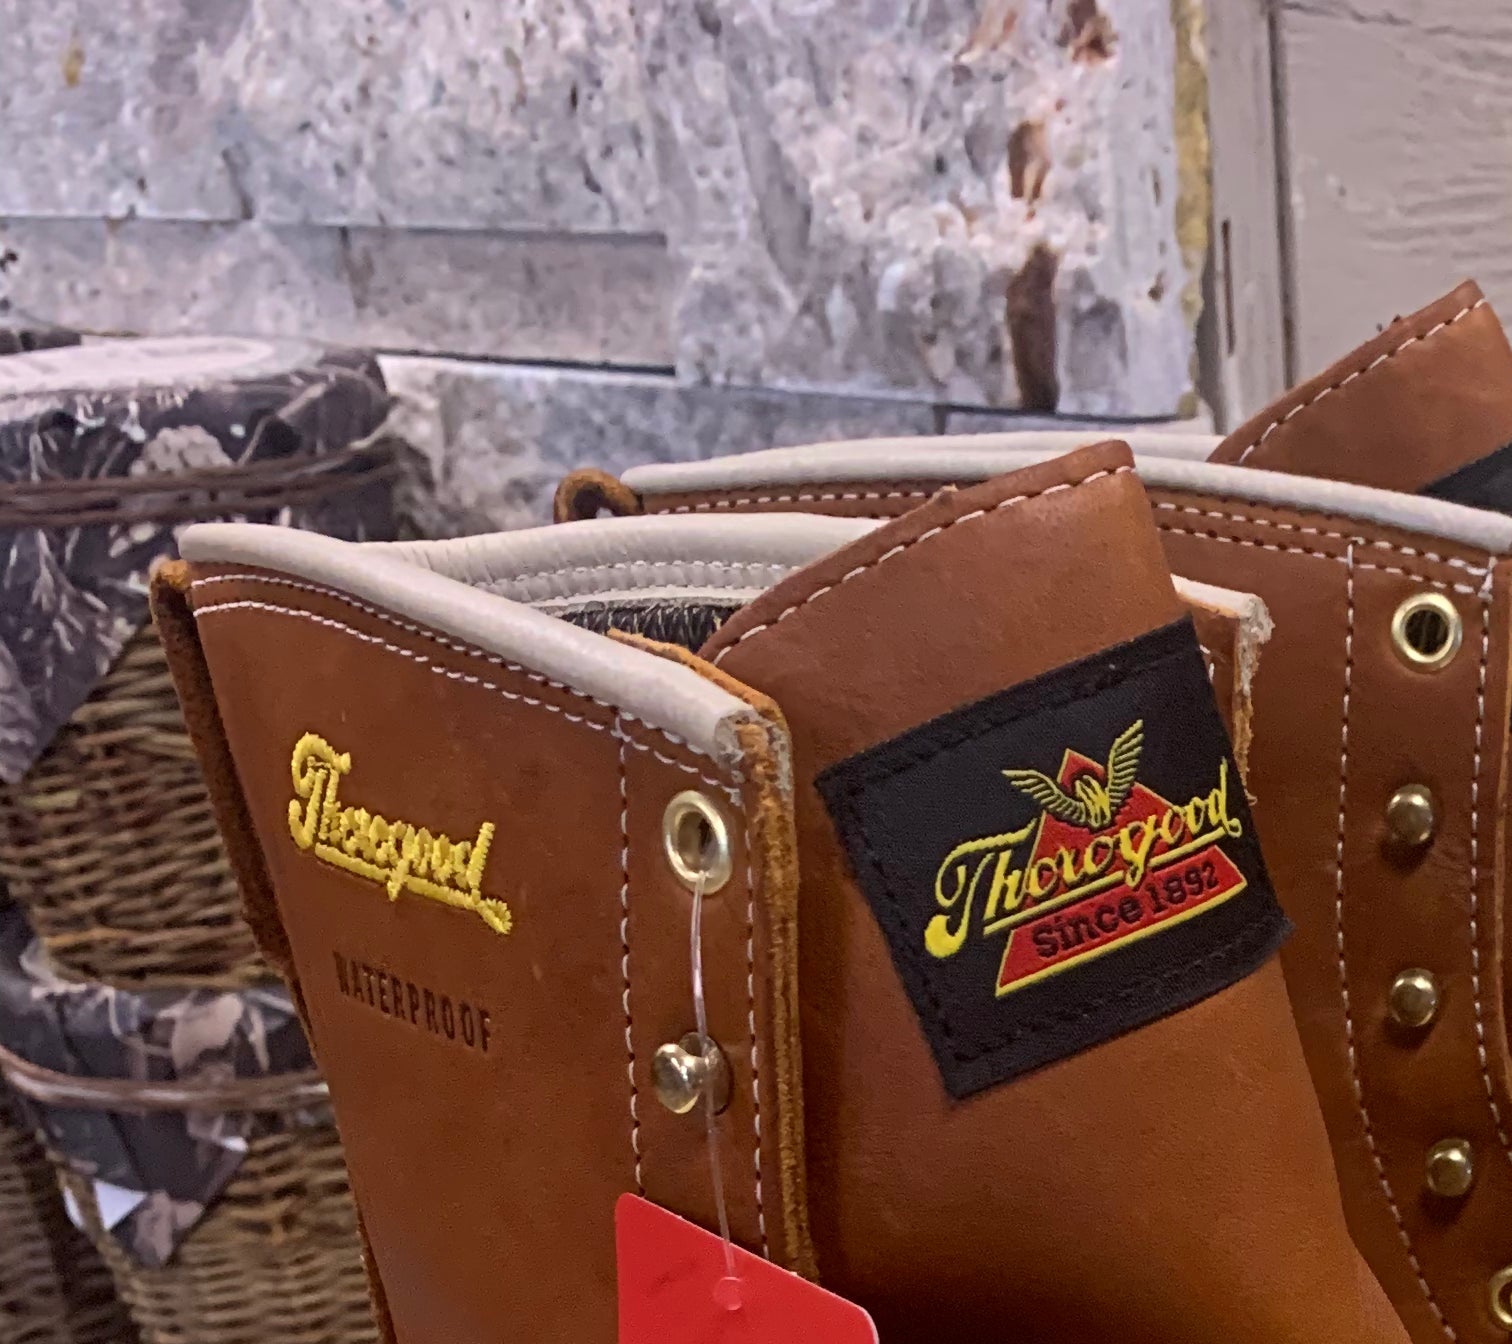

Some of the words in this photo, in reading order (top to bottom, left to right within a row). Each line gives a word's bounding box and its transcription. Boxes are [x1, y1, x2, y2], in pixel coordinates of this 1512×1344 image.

[289, 732, 513, 935] Thorogood
[925, 757, 1242, 958] Thorogood
[1032, 895, 1143, 958] Since
[1149, 861, 1220, 914] 1892
